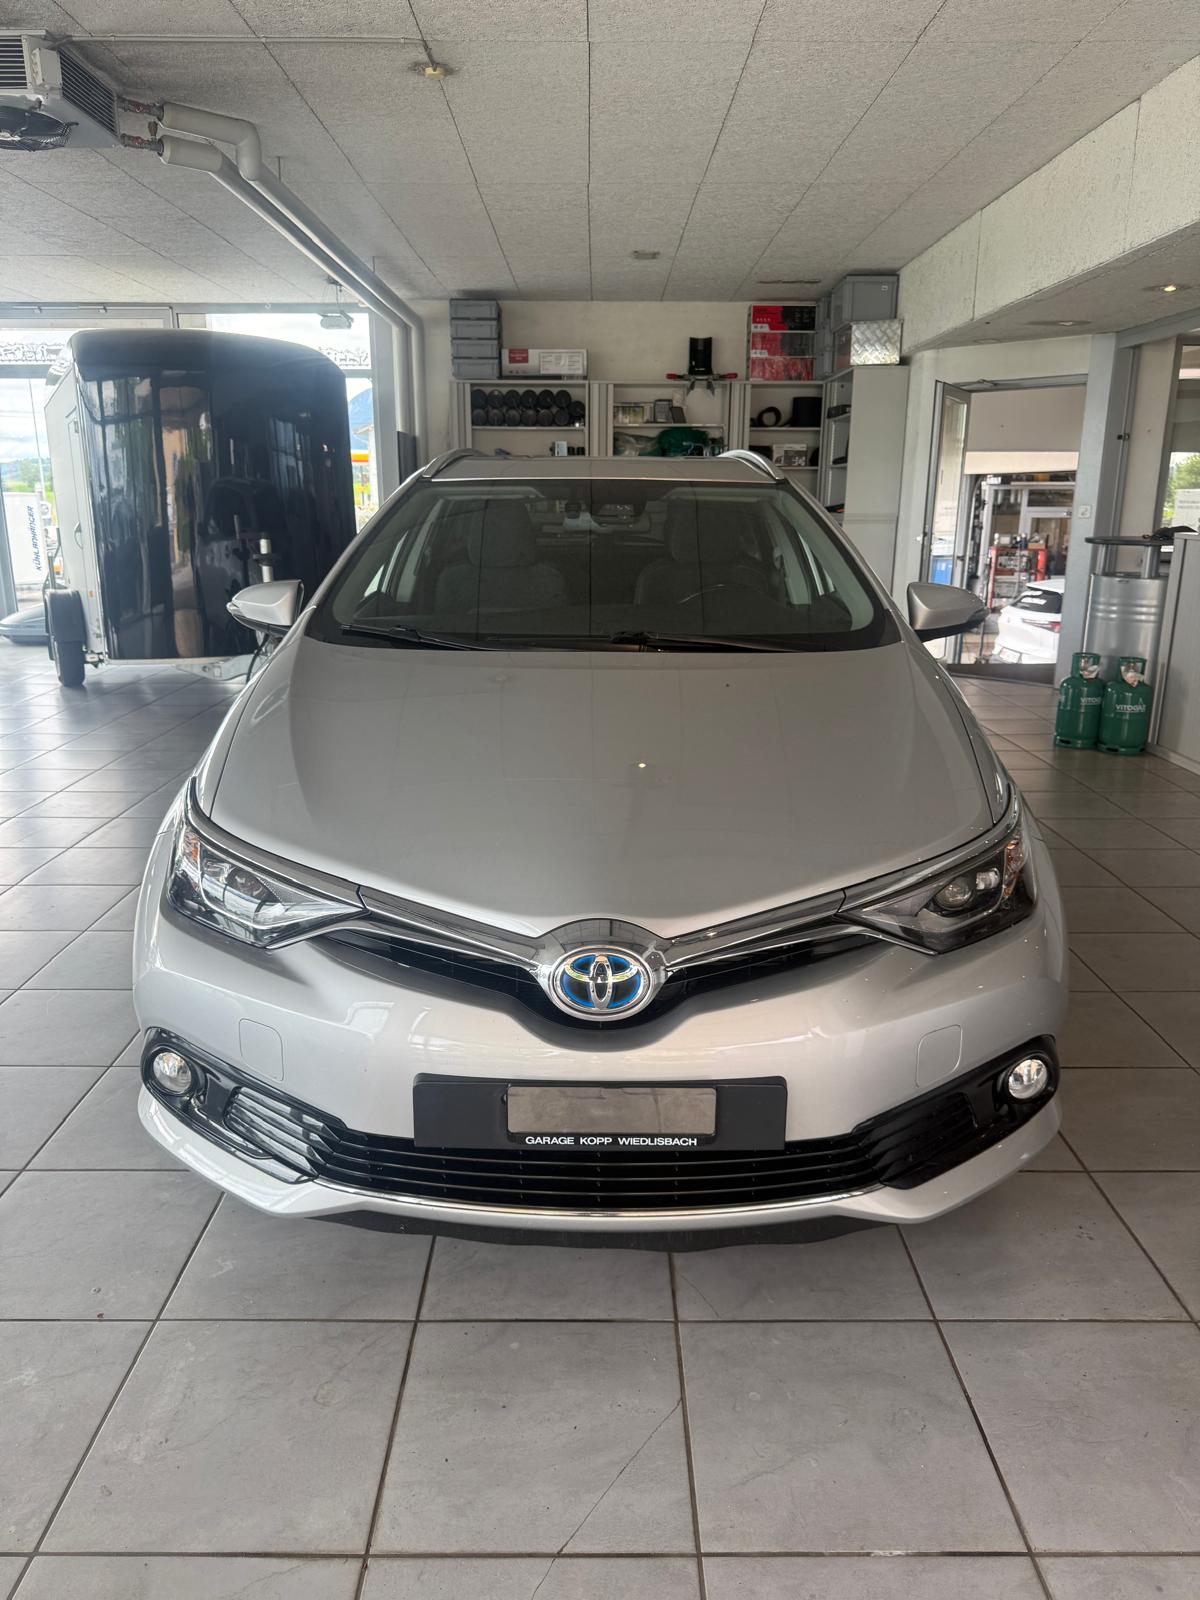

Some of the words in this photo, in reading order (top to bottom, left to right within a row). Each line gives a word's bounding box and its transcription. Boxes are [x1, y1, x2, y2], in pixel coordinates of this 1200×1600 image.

[525, 1136, 575, 1145] GARAGE
[579, 1136, 613, 1145] KOPP
[617, 1137, 698, 1146] WIEDLISBACH
